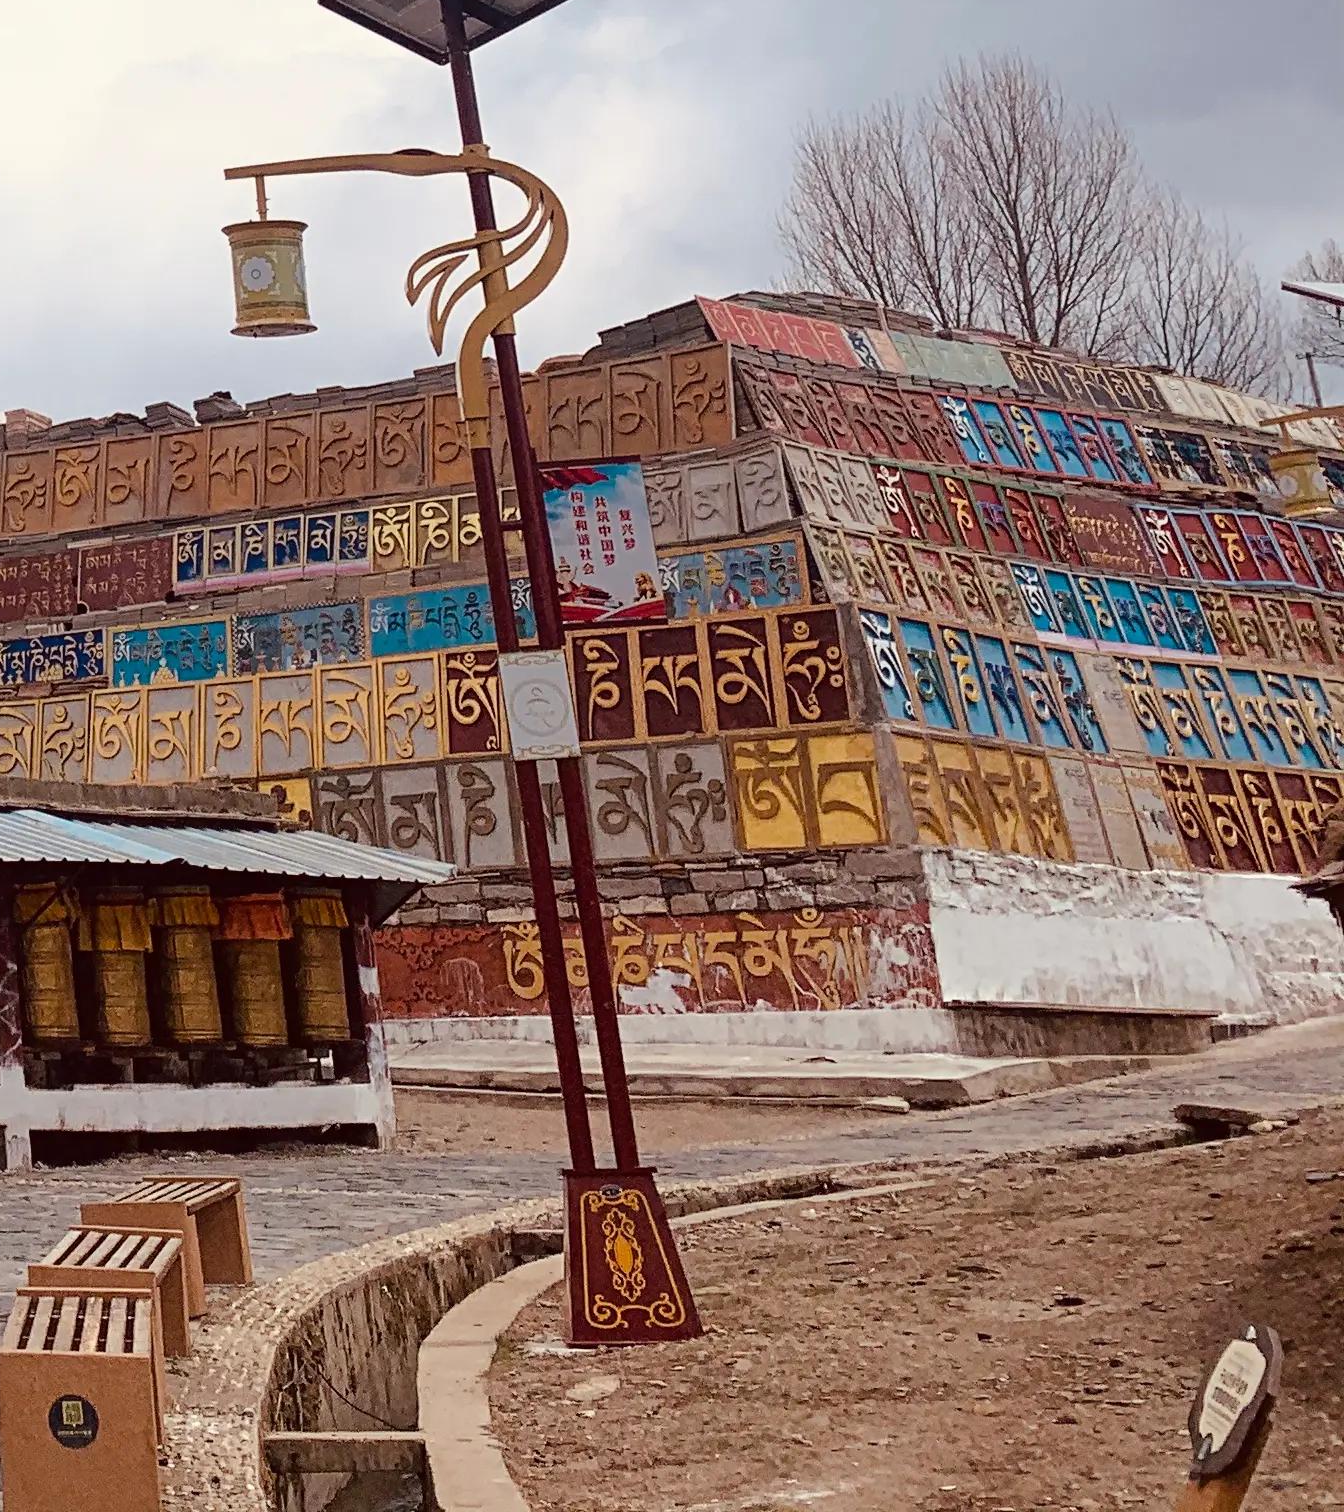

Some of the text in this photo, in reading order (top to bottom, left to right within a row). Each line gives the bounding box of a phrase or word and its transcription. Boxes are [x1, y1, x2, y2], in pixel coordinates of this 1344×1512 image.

[570, 490, 595, 575] 构建和谐社会
[594, 496, 616, 567] 共筑中国梦
[618, 509, 636, 551] 复兴梦
